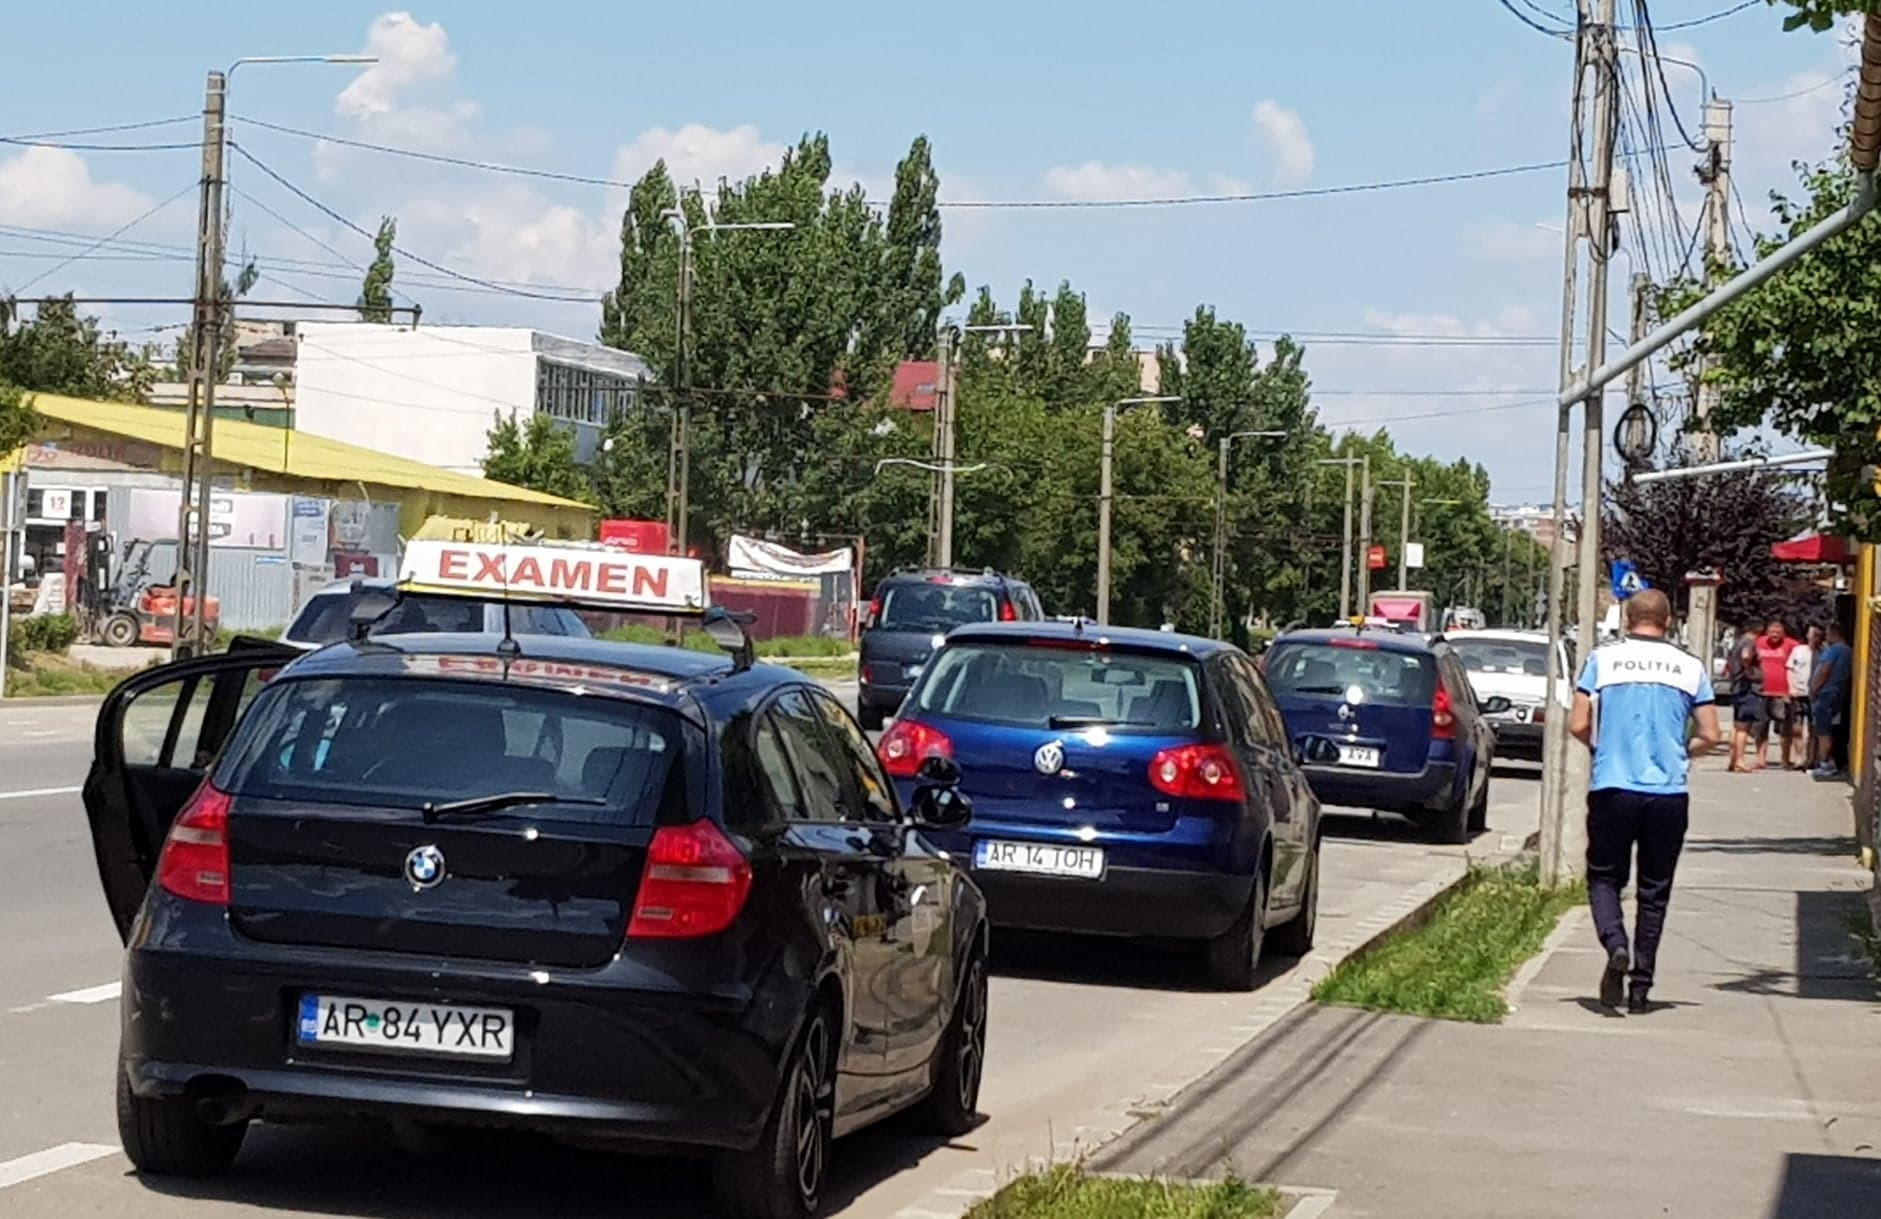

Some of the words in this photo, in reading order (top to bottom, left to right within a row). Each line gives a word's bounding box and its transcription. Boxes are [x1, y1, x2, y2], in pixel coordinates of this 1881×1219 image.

[438, 549, 670, 599] EXAMEN
[989, 843, 1017, 864] AR
[1026, 844, 1044, 866] 14
[1054, 848, 1095, 870] TOH
[322, 1002, 367, 1038] AR
[381, 1006, 422, 1043] 84
[431, 1009, 507, 1049] YXR
